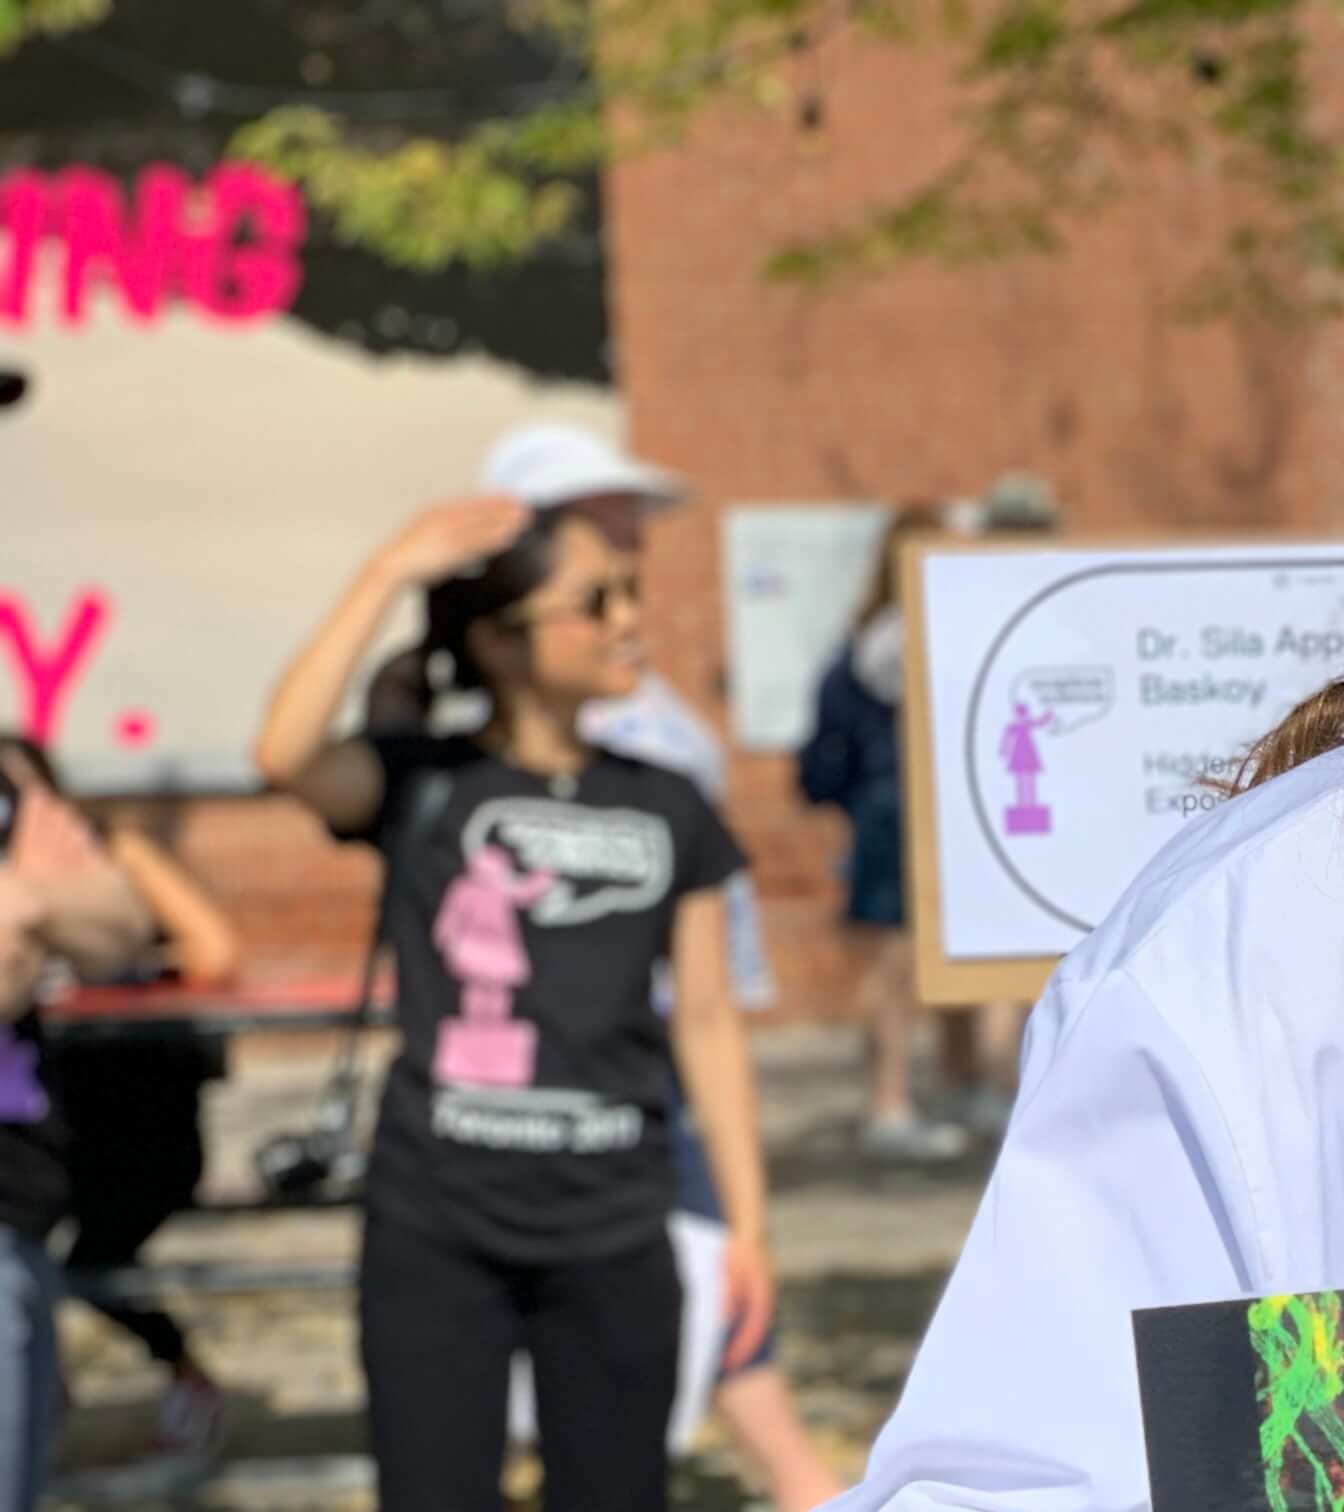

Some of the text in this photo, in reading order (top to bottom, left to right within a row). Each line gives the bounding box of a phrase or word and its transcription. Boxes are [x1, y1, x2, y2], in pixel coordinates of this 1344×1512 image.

[1136, 626, 1190, 661] Dr.
[1200, 623, 1265, 660] Sila
[1139, 674, 1266, 708] Baskoy
